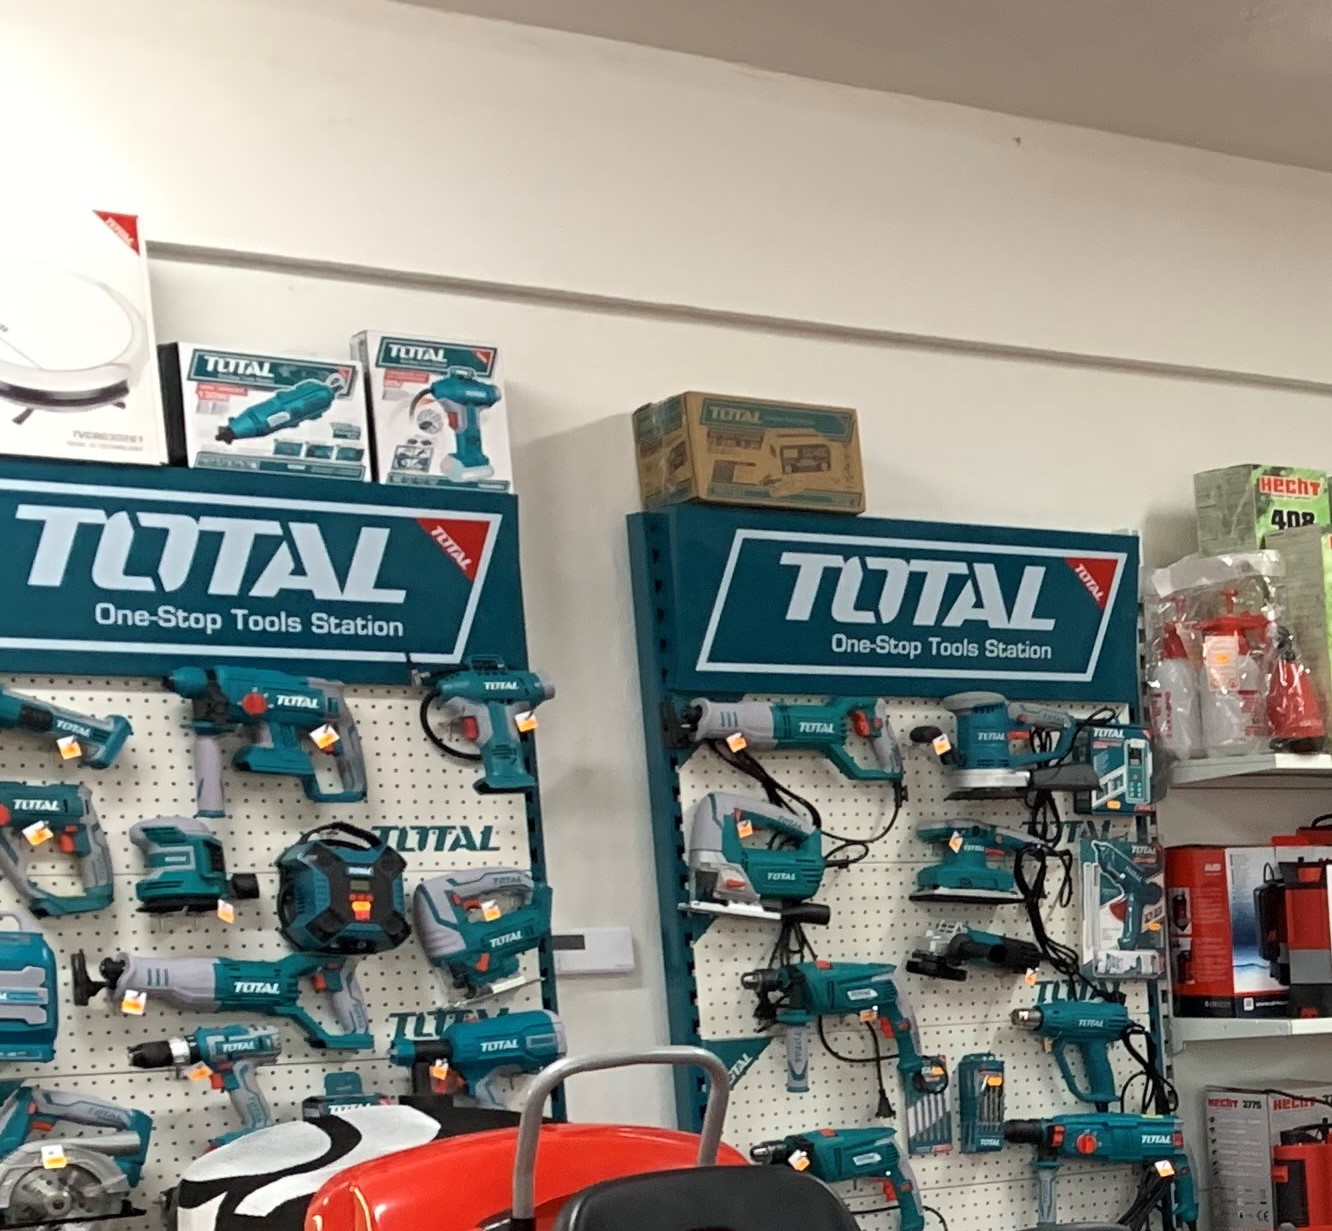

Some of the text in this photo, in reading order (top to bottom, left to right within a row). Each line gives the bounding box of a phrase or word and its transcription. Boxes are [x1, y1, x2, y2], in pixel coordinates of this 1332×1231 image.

[388, 343, 448, 363] TOTAL
[203, 355, 275, 378] TOTAL
[710, 405, 762, 425] TOTAL
[14, 503, 408, 605] TOTAL
[430, 524, 473, 572] TOTAL
[1073, 562, 1104, 602] TOTAL
[780, 551, 1056, 631] TOTAL
[95, 602, 404, 638] One-Stop Tools Station
[831, 633, 1052, 660] One-Stop Tools Station
[483, 681, 520, 691] TOTAL
[276, 694, 320, 710] TOTAL
[57, 719, 91, 738] TOTAL
[799, 721, 835, 734] TOTAL
[977, 731, 1005, 741] TOTAL
[1093, 727, 1125, 739] TOTAL
[13, 798, 61, 812] TOTAL
[370, 825, 501, 853] TOTAL
[767, 872, 796, 881] TOTAL
[489, 929, 523, 949] TOTAL
[234, 981, 281, 995] TOTAL
[222, 1040, 256, 1053] TOTAL
[480, 1038, 520, 1053] TOTAL
[1242, 1099, 1262, 1110] 3775
[1141, 1134, 1172, 1144] TOTAL
